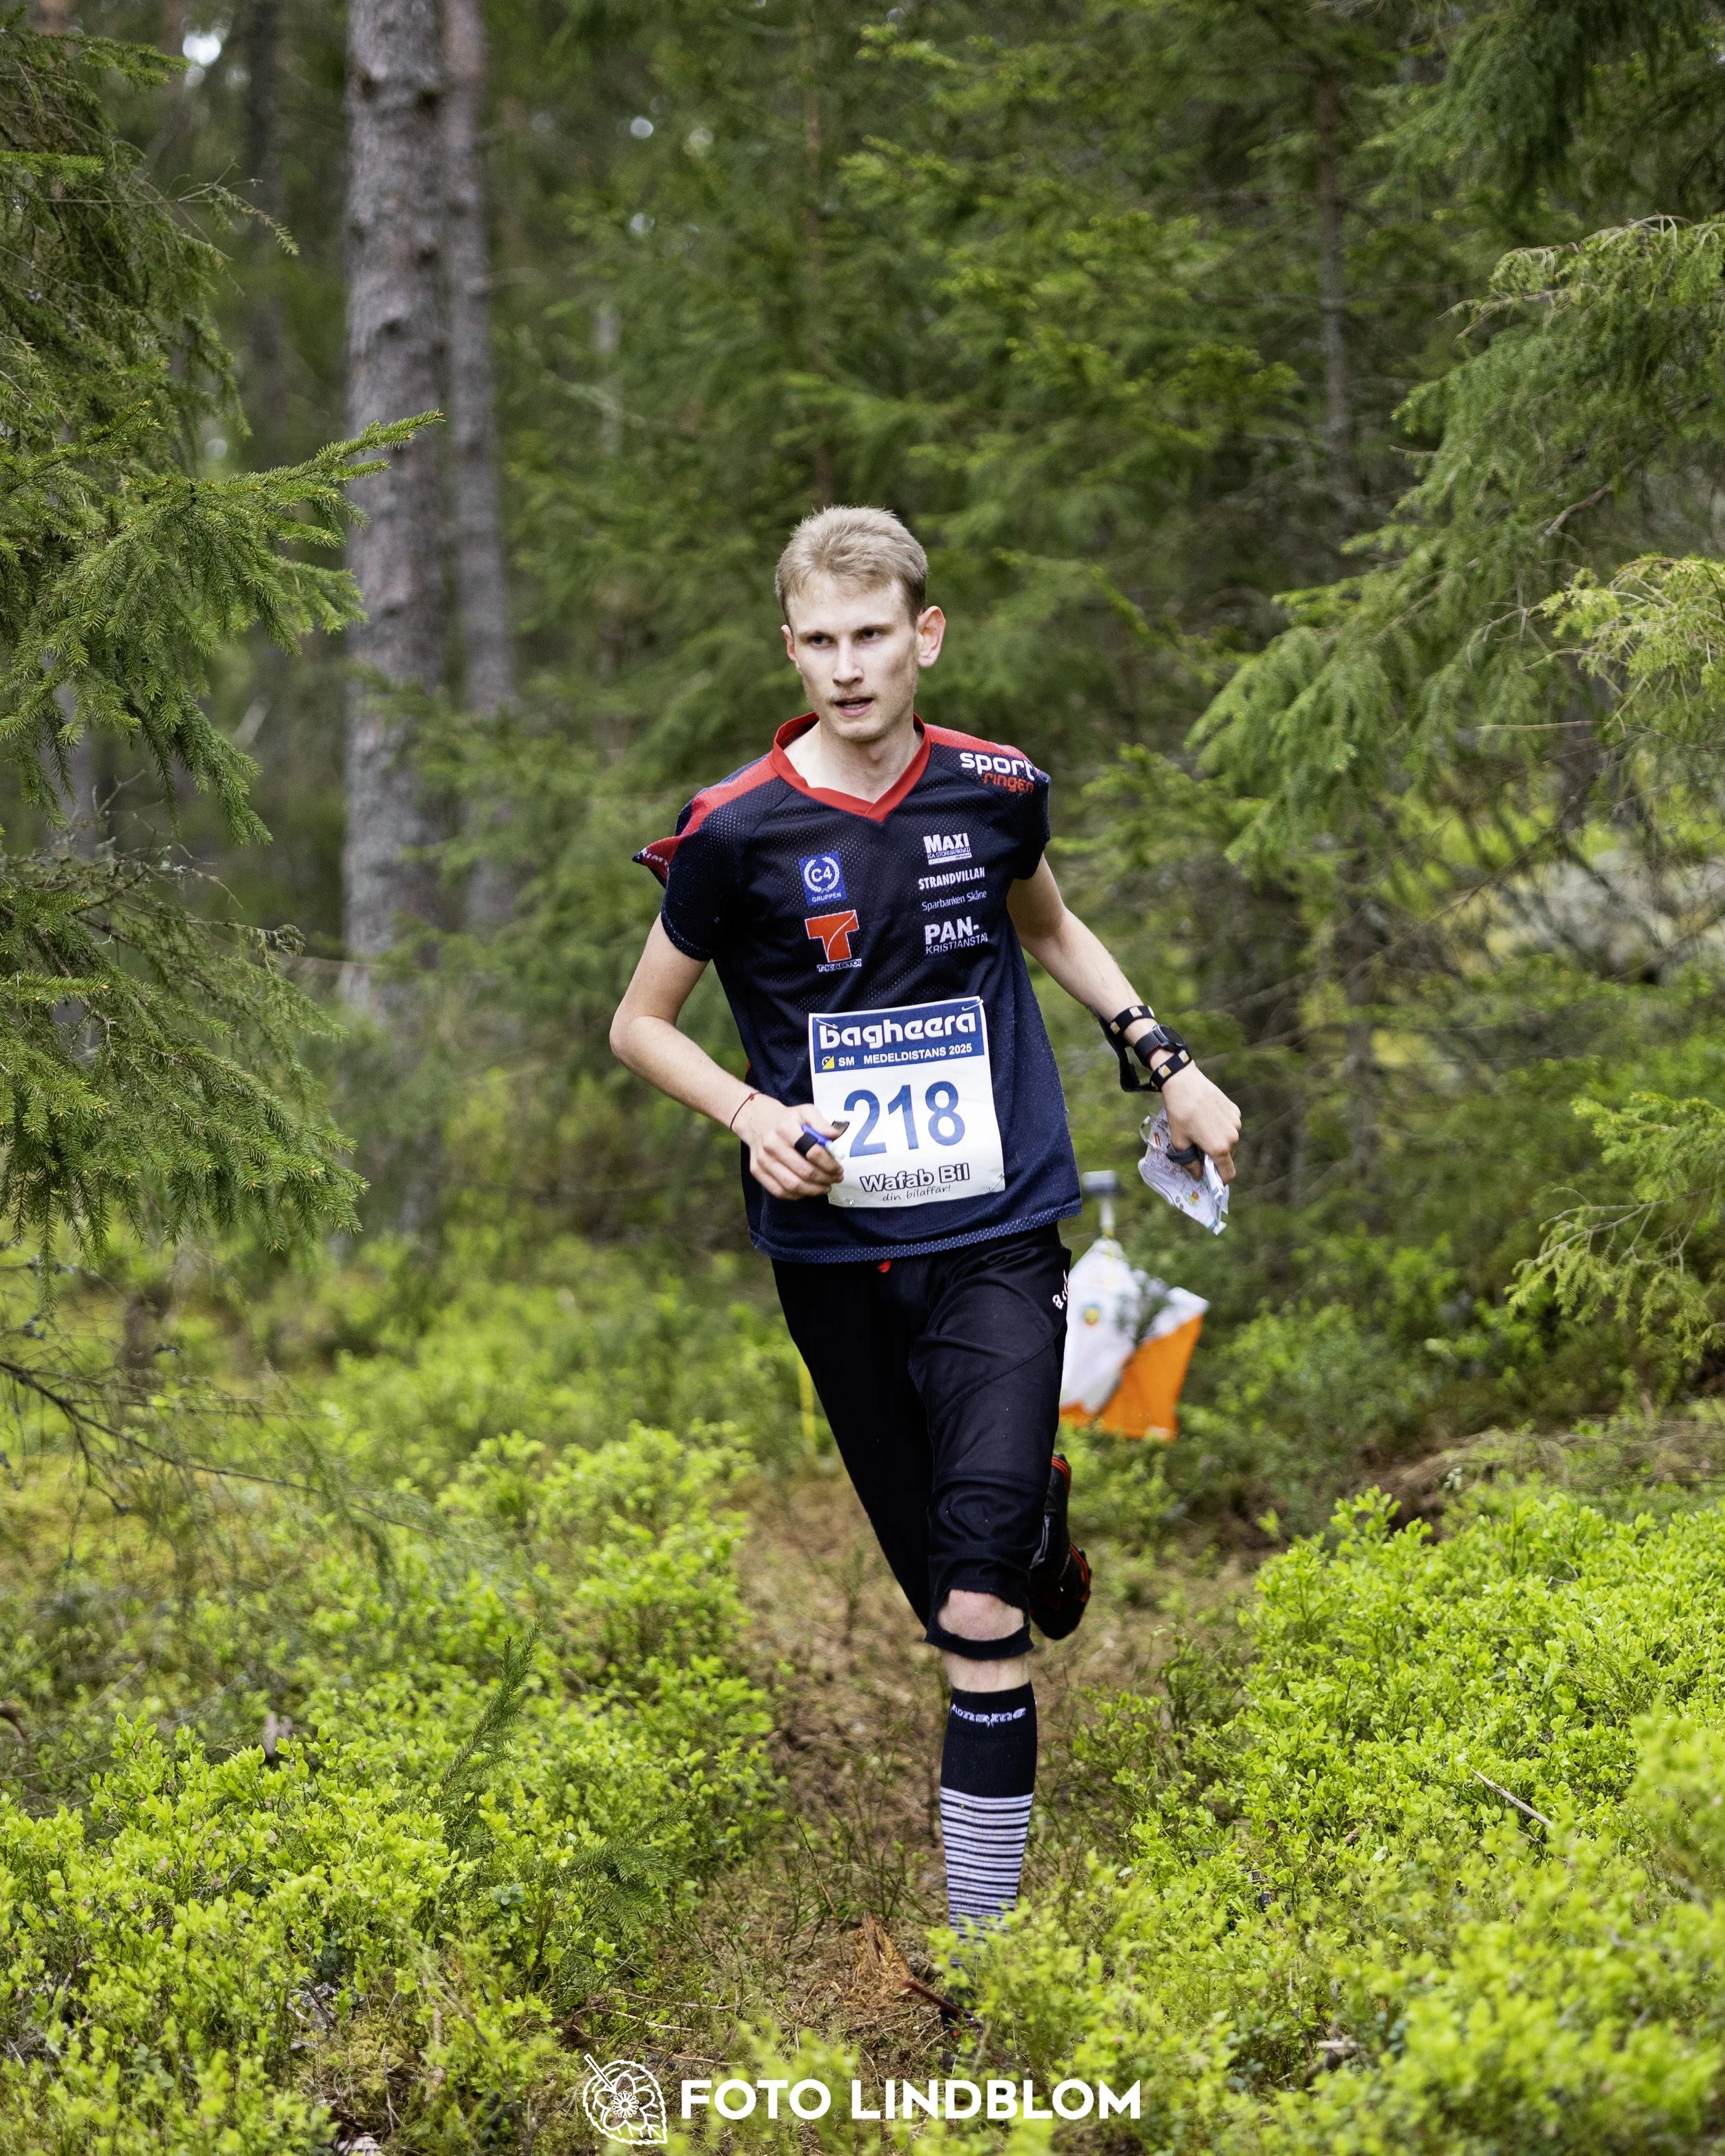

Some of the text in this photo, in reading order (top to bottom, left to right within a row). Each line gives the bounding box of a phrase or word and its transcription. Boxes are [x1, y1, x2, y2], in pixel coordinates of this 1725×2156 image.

[960, 752, 1035, 781] sport
[923, 833, 969, 853] MAXI
[811, 866, 832, 882] C4
[918, 867, 985, 890] STRANDVILLAN
[811, 892, 842, 902] GRUPPEN
[922, 890, 987, 912] Sparbanken Skåne
[819, 1012, 976, 1049] bagheera
[838, 1043, 972, 1067] SM MEDELDISTANS 2025
[844, 1080, 965, 1158] 218
[860, 1163, 970, 1192] Wafab Bil
[883, 1185, 951, 1202] din bilaffär!
